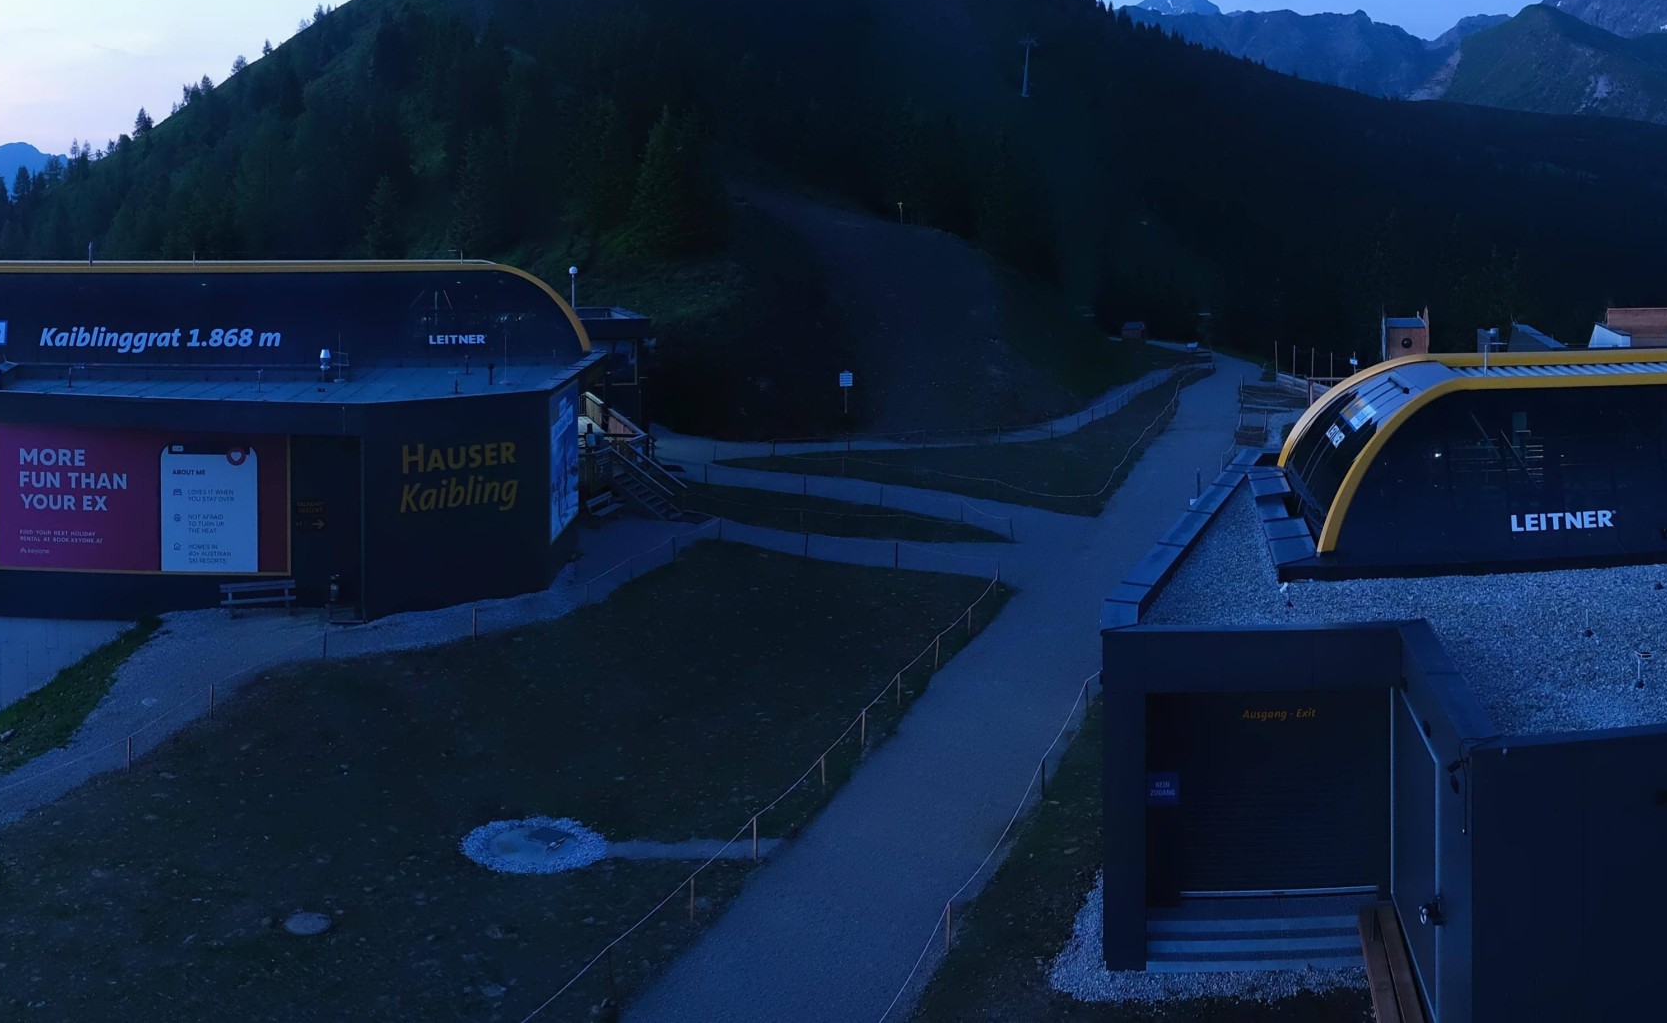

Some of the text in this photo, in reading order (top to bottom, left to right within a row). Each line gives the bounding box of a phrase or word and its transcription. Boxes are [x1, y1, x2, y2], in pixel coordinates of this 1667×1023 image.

[39, 327, 281, 353] Kaiblinggrat 1.868 m
[428, 334, 486, 345] LEITNER
[19, 447, 86, 466] MORE
[402, 441, 516, 475] HAUSER
[19, 471, 128, 490] FUN THAN
[20, 493, 108, 511] YOUR EX
[400, 475, 519, 514] Kaibling
[1510, 509, 1615, 532] LEITNER
[1242, 709, 1288, 721] Ausgang
[1296, 707, 1317, 718] Exit
[1149, 789, 1177, 797] ZUGANG
